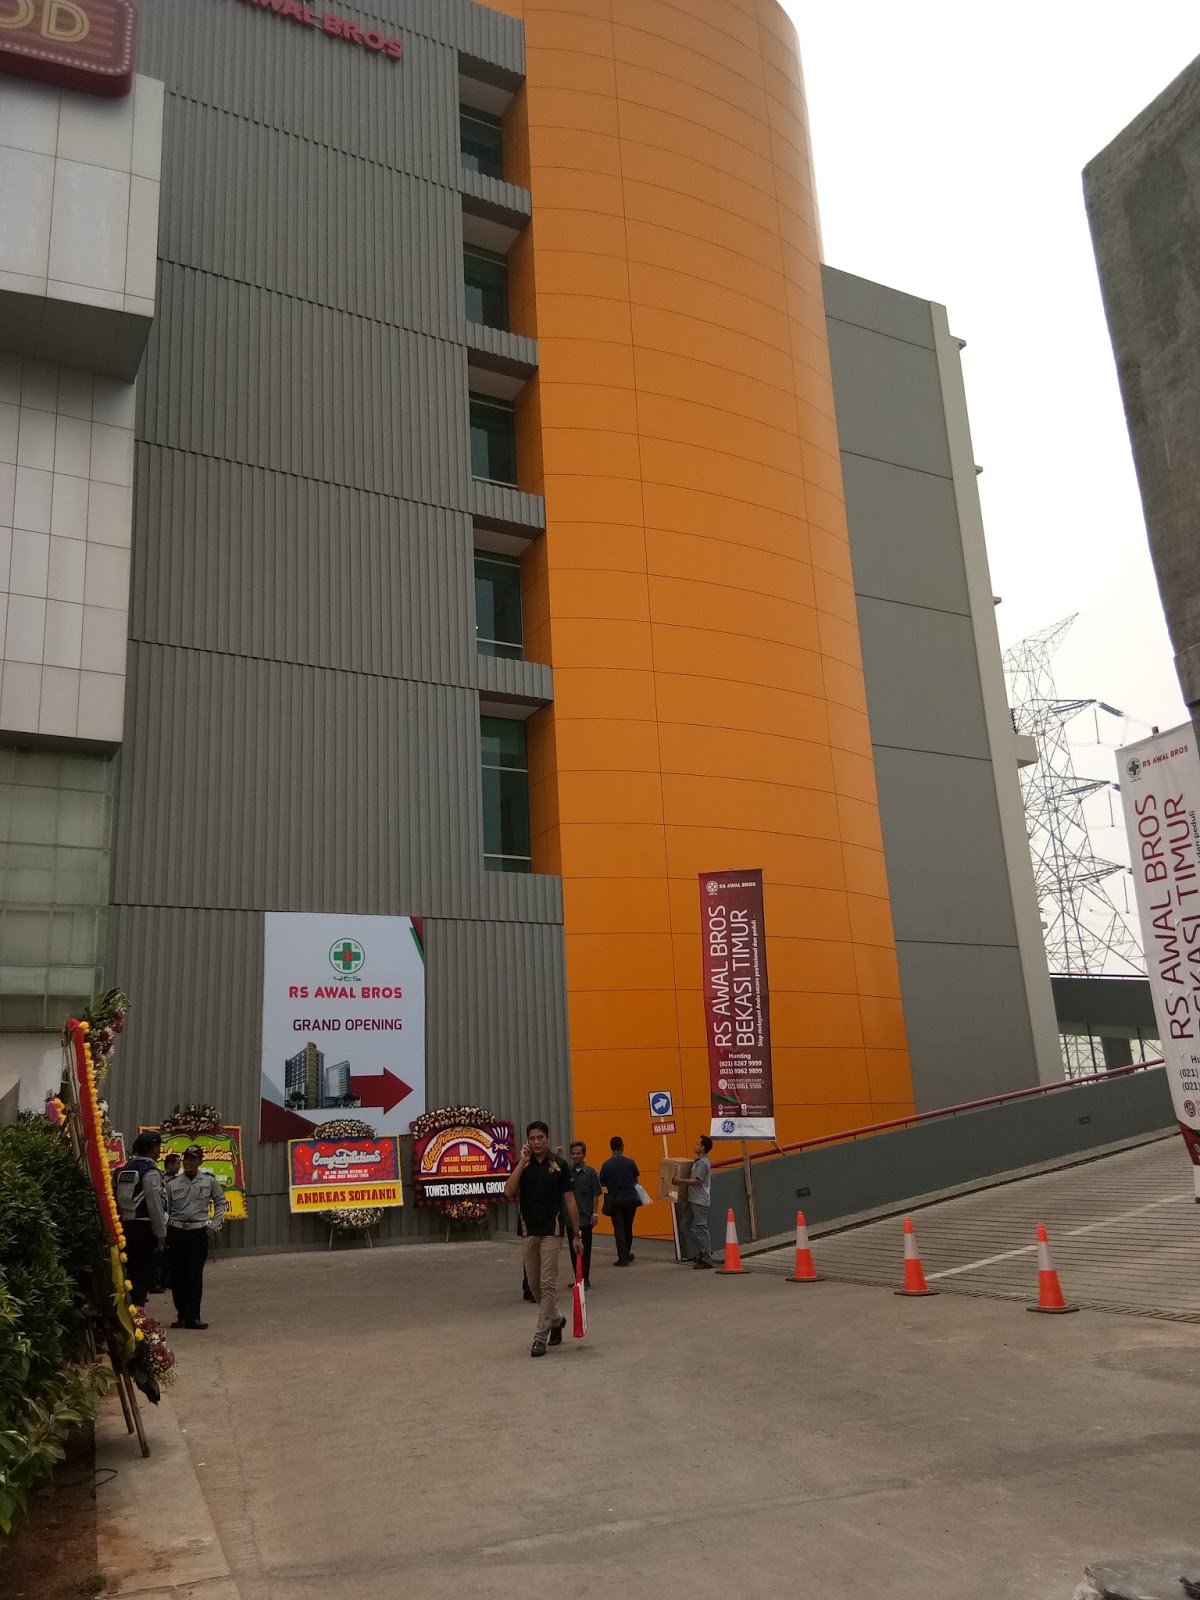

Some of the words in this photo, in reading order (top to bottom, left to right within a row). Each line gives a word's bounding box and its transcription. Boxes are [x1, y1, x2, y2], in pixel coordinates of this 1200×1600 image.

[323, 13, 403, 60] BROS
[1142, 760, 1151, 768] RS
[1152, 752, 1169, 764] AWAL
[1170, 745, 1189, 758] BROS
[1135, 794, 1168, 884] BROS
[1164, 794, 1199, 906] TIMUR
[708, 905, 728, 957] BROS
[730, 909, 751, 972] TIMUR
[1150, 890, 1185, 985] AWAL
[289, 986, 309, 998] RS
[314, 987, 356, 999] AWAL
[361, 987, 402, 999] BROS
[711, 961, 731, 1016] AWAL
[293, 1019, 341, 1031] GRAND
[345, 1019, 402, 1031] OPENING
[713, 1021, 732, 1047] RS
[733, 977, 755, 1046] BEKASI
[1165, 995, 1194, 1039] RS
[1180, 1069, 1199, 1079] (021)
[296, 1191, 346, 1205] ANDREAS
[348, 1188, 397, 1201] SOFIANDI
[424, 1184, 449, 1197] TOWER
[450, 1182, 485, 1196] BERSAMA
[486, 1181, 506, 1193] GROU
